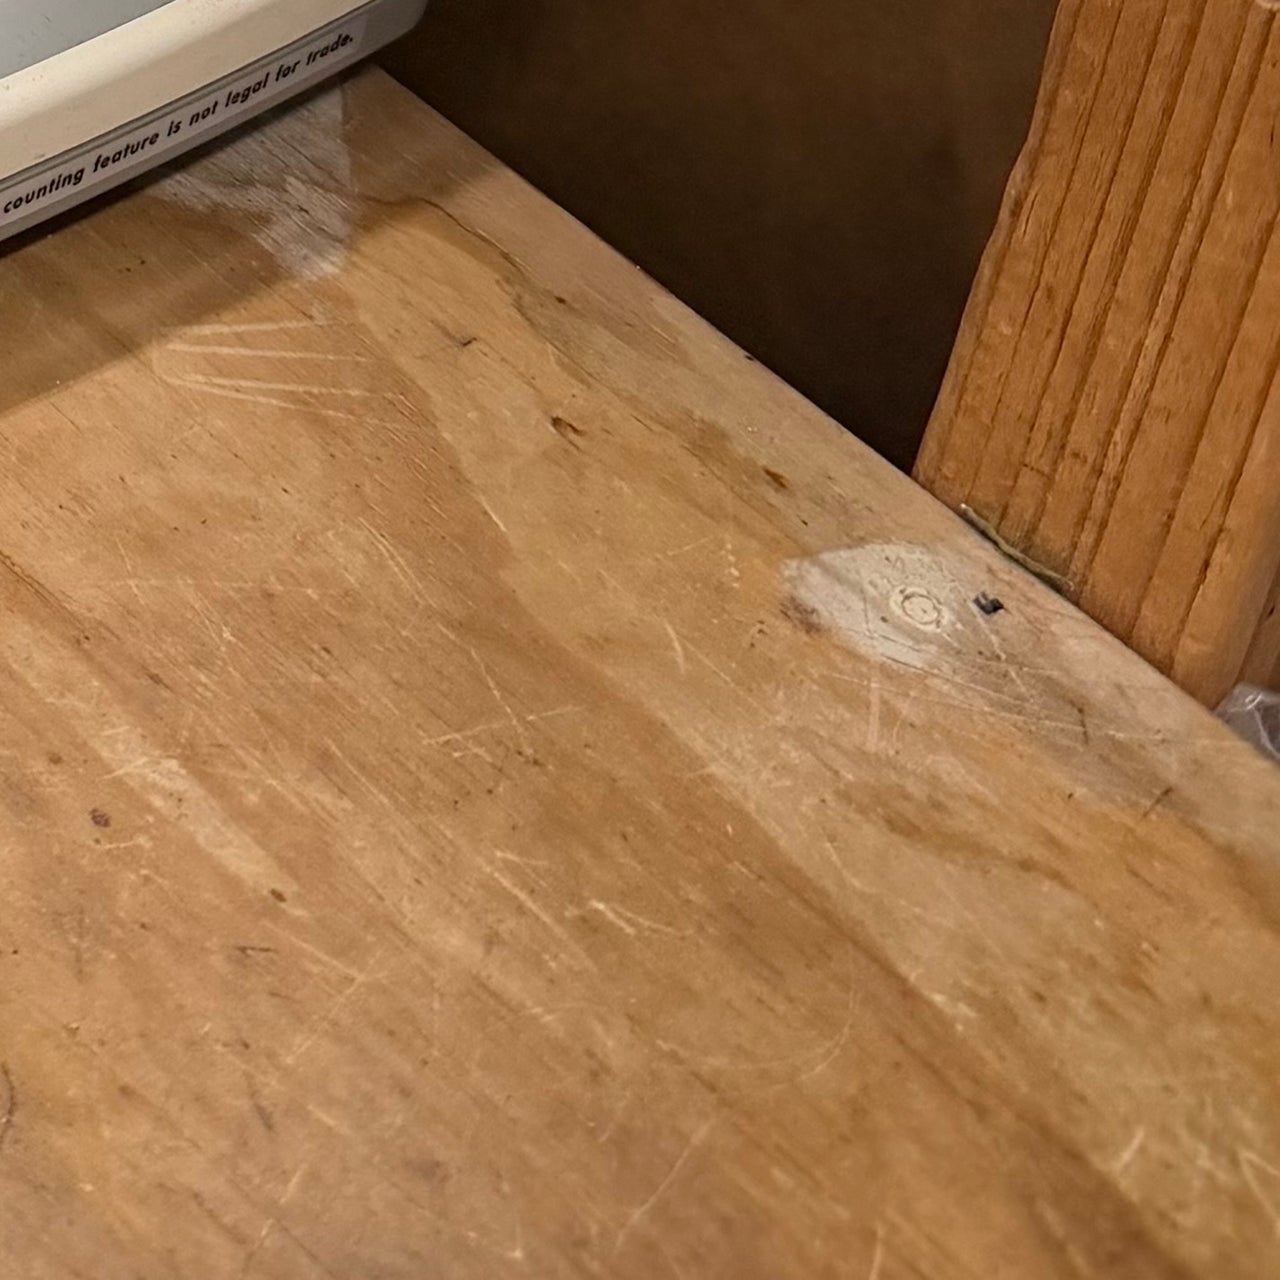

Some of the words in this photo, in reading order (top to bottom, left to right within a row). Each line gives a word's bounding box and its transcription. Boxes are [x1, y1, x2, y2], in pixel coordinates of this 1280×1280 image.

[2, 167, 86, 215] counting
[92, 130, 160, 175] feature
[166, 117, 182, 138] is
[188, 99, 218, 128] not
[224, 72, 272, 108] legal
[274, 57, 300, 83] for
[305, 30, 355, 69] trade.
